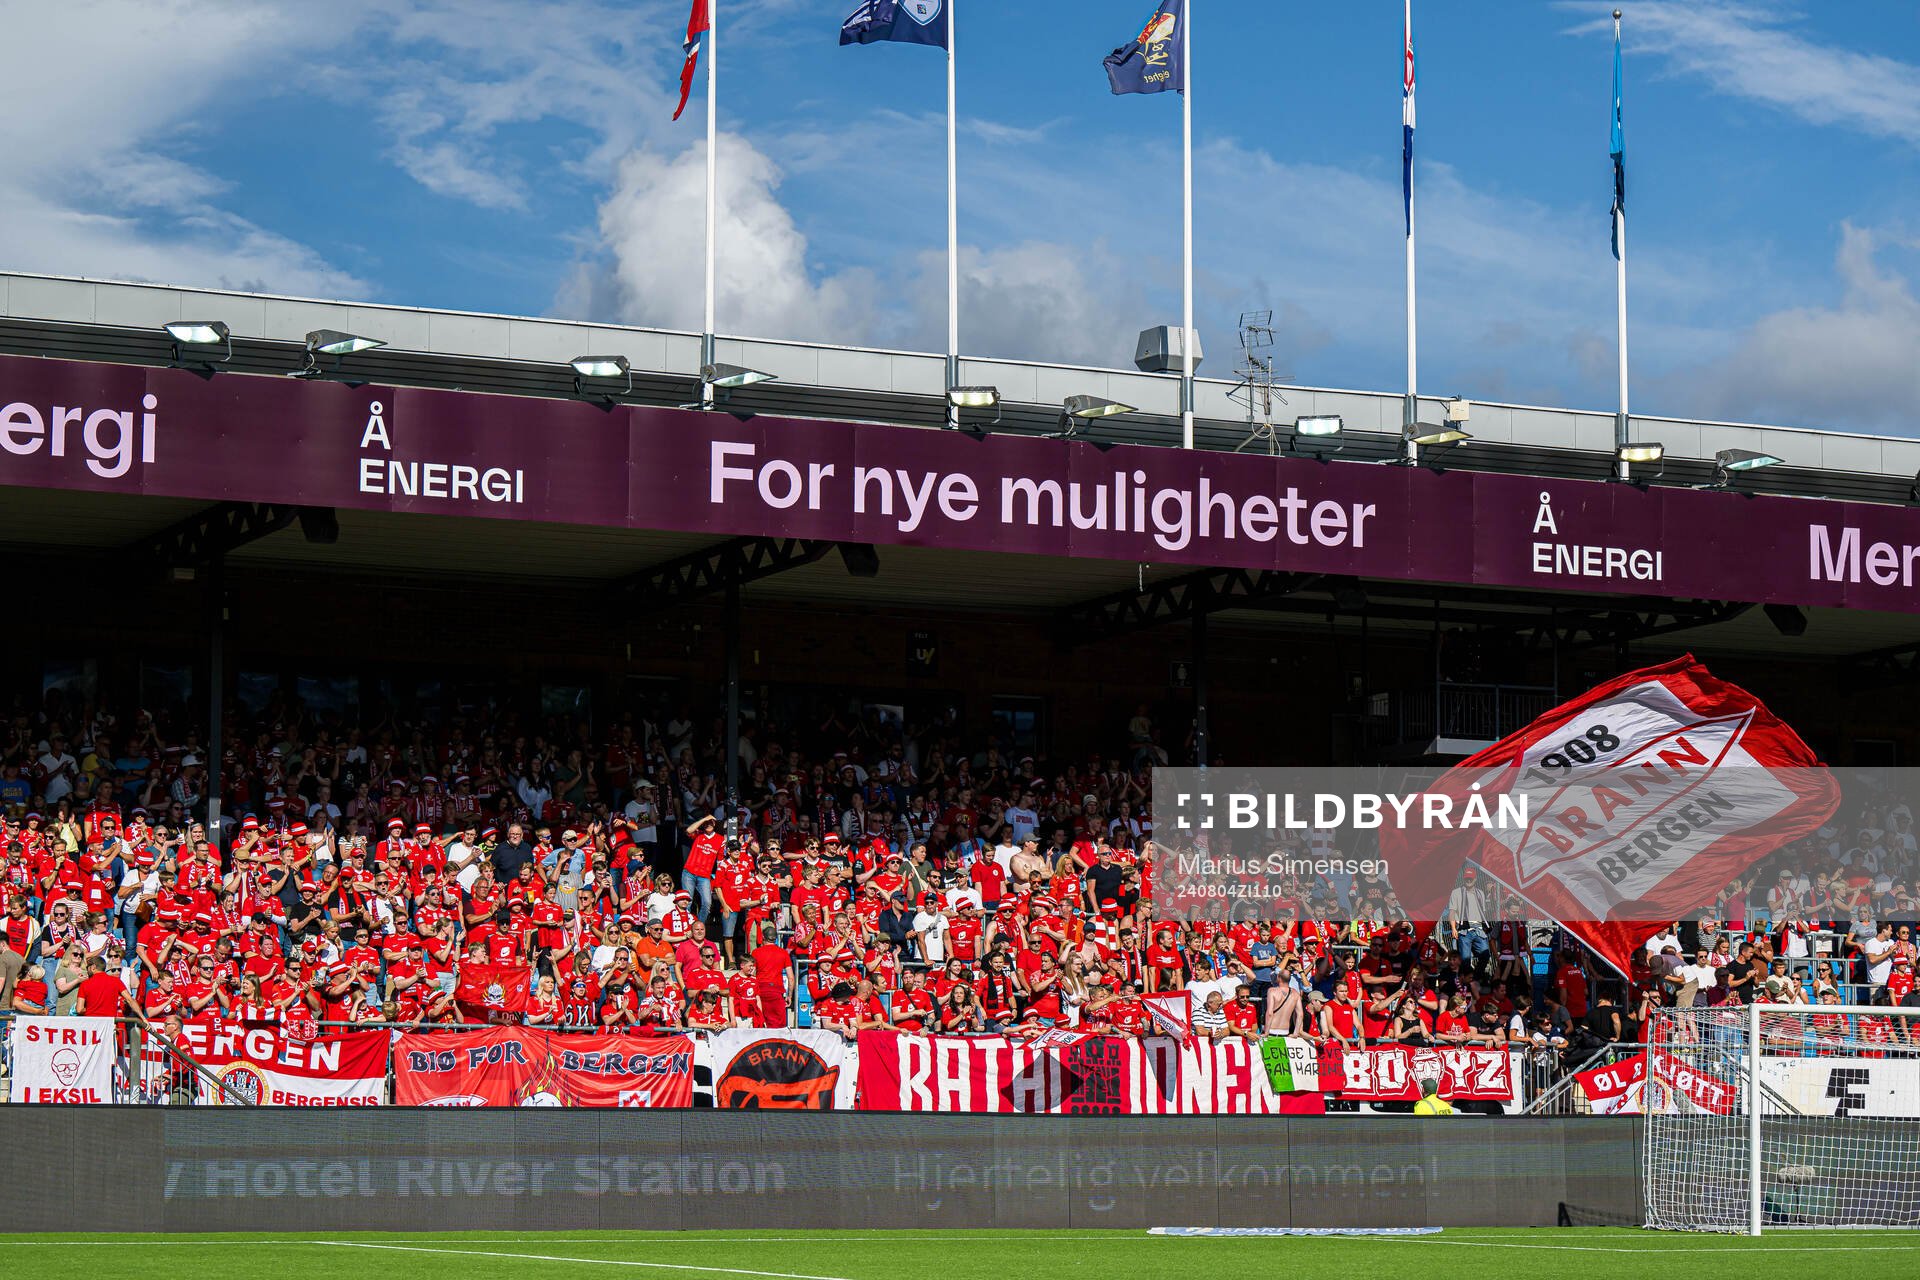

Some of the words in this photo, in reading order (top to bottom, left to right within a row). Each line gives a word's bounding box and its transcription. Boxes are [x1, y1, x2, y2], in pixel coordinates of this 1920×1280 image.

[0, 394, 156, 478] ergi
[360, 401, 391, 450] Å
[359, 458, 525, 503] ENERGI
[710, 441, 834, 510] For
[853, 465, 979, 533] nye
[1000, 470, 1377, 551] muligheter
[1533, 491, 1558, 535] Å
[1533, 543, 1663, 581] ENERGI
[1523, 724, 1620, 786] 1908
[1536, 736, 1710, 854] BRANN
[1596, 791, 1736, 885] BERGEN
[26, 1024, 102, 1046] STRIL
[748, 1047, 810, 1067] BRANN
[1262, 1047, 1304, 1060] LENGE
[466, 1040, 530, 1073] FOR
[559, 1049, 693, 1080] BERGEN
[1343, 1048, 1511, 1096] BOYZ
[1593, 1070, 1627, 1092] ØL
[205, 1159, 377, 1199] Hotel
[398, 1156, 556, 1198] River
[573, 1154, 786, 1197] Station
[893, 1151, 1117, 1212] Hjertelig
